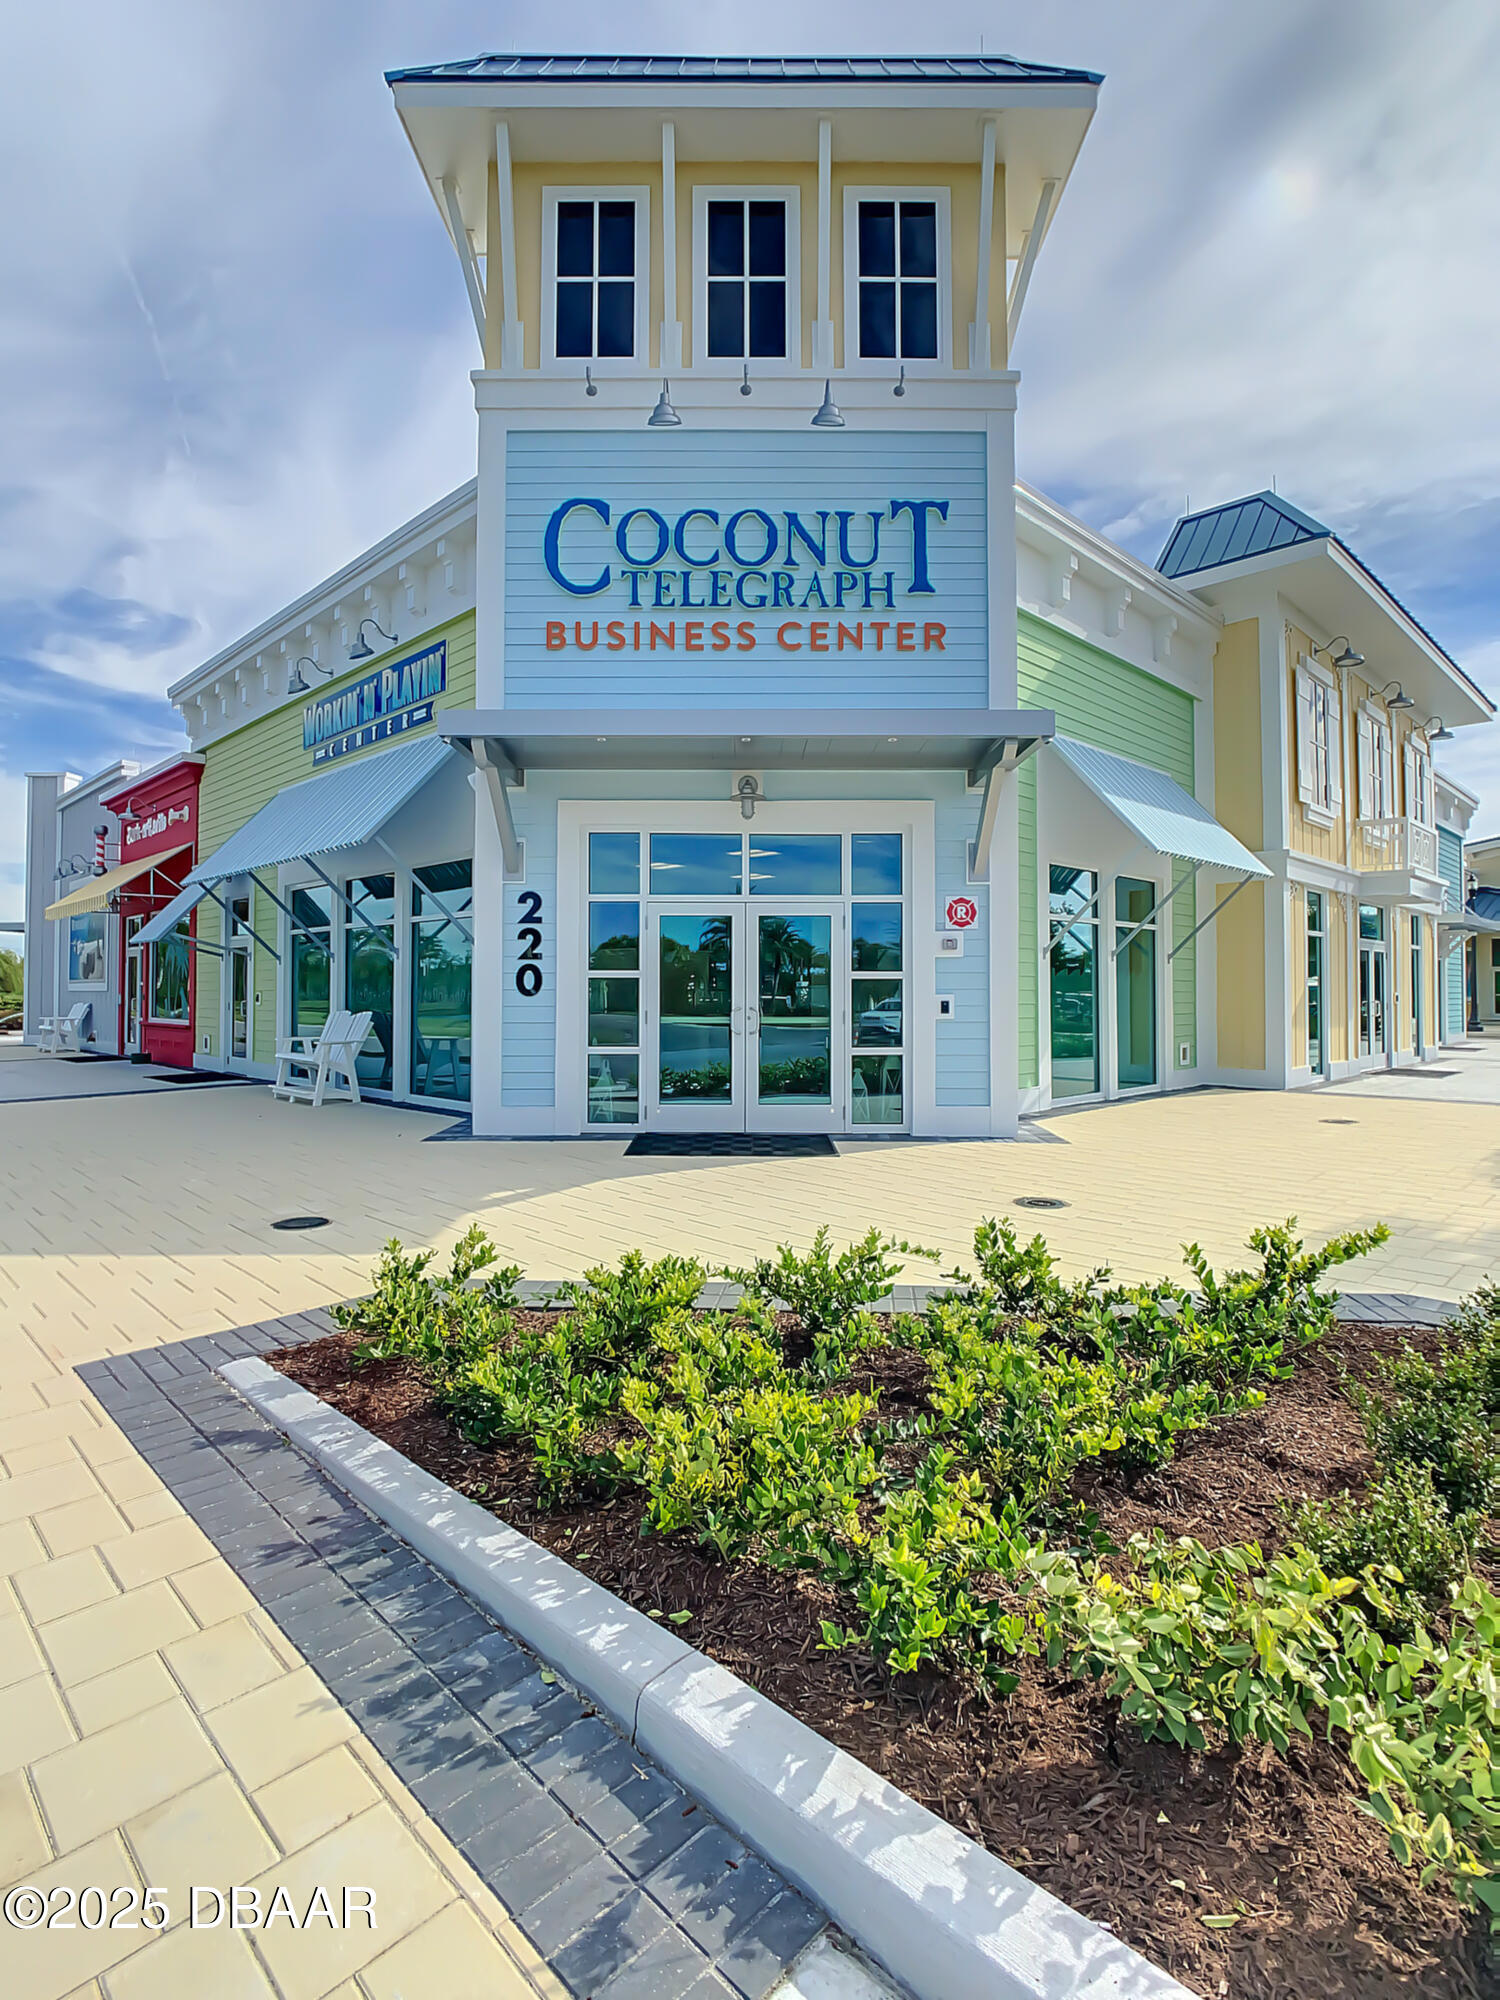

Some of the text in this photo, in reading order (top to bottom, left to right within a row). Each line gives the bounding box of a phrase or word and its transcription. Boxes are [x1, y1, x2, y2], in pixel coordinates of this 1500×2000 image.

[544, 498, 949, 596] COCONUT
[621, 570, 896, 609] TELEGRAPH
[546, 621, 947, 651] BUSINESS CENTER
[329, 713, 409, 757] CENTER
[957, 906, 967, 919] R
